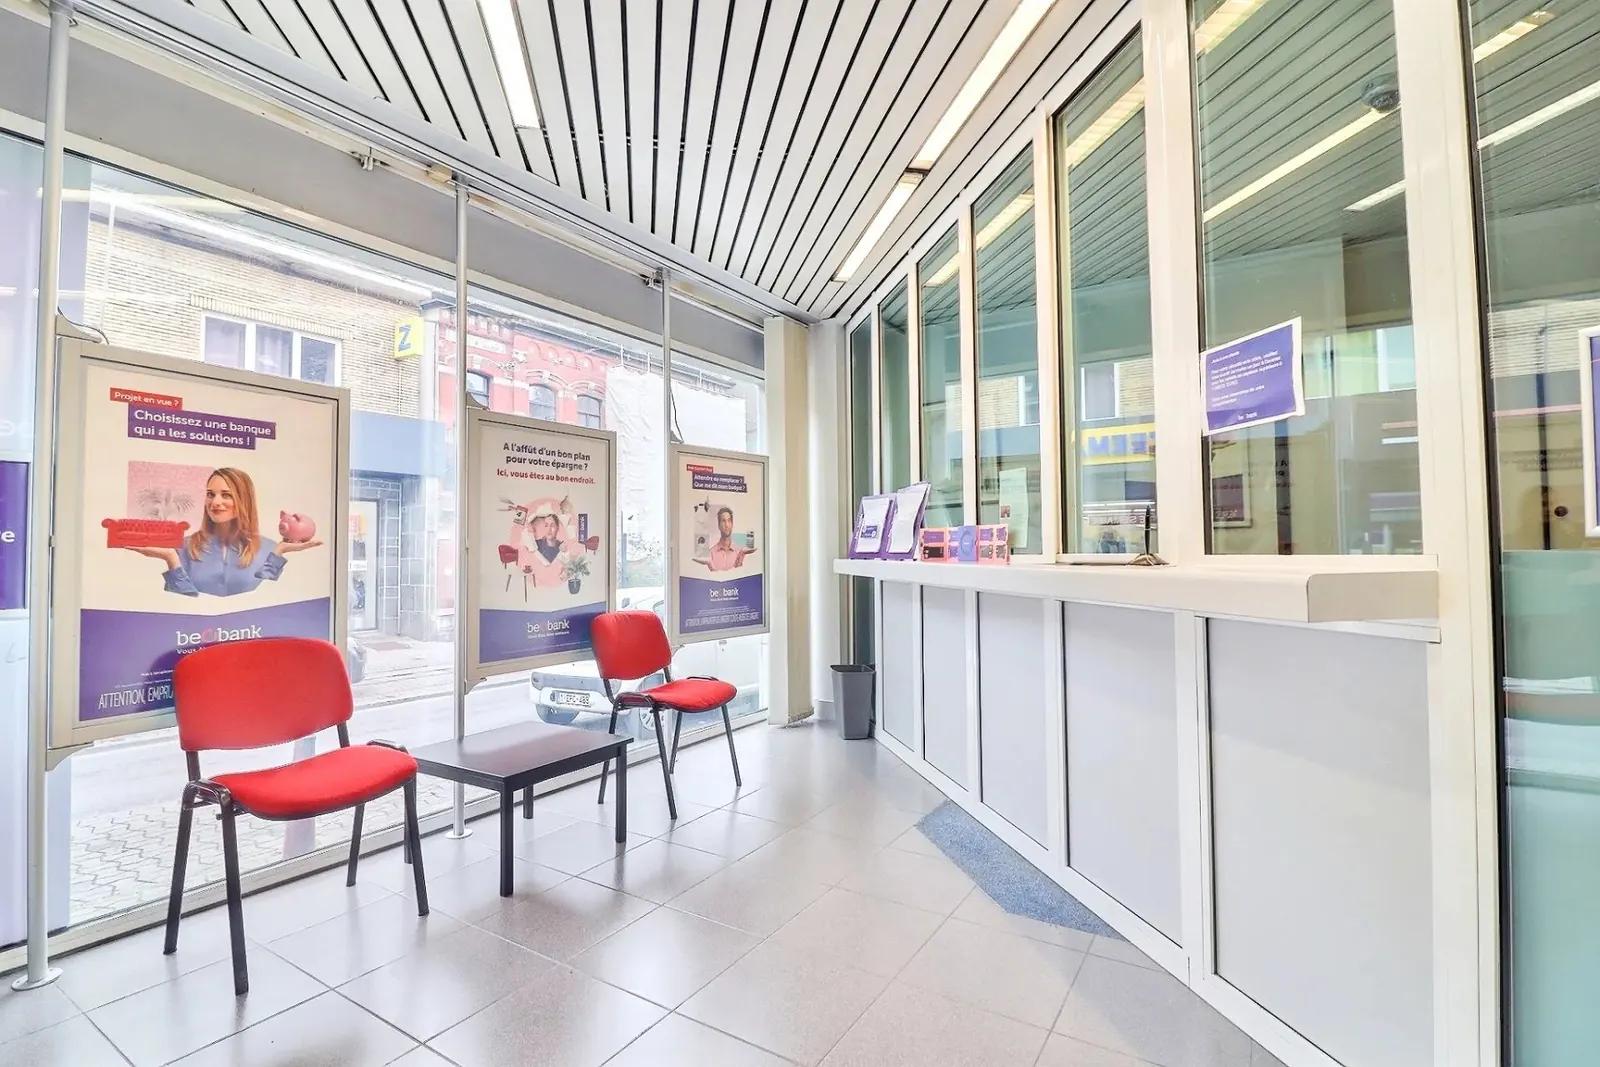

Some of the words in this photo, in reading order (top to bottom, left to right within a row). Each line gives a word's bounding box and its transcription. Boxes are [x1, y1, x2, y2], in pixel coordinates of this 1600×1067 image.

[398, 324, 411, 352] Z
[114, 391, 142, 402] Projet
[157, 399, 173, 407] vue
[134, 409, 202, 427] Choisissez
[205, 420, 227, 430] une
[229, 422, 272, 436] banque
[134, 425, 155, 436] qui
[169, 428, 187, 439] les
[189, 432, 244, 445] solutions
[246, 436, 250, 445] !
[503, 442, 509, 451] A
[511, 443, 537, 455] l'affût
[538, 447, 556, 457] d'un
[557, 449, 573, 459] bon
[574, 452, 591, 462] plan
[506, 456, 527, 464] pour
[528, 458, 550, 467] votre
[551, 460, 583, 471] épargne
[584, 463, 588, 471] ?
[497, 468, 509, 477] Ici,
[530, 471, 545, 480] êtes
[556, 474, 569, 482] bon
[0, 530, 15, 543] e
